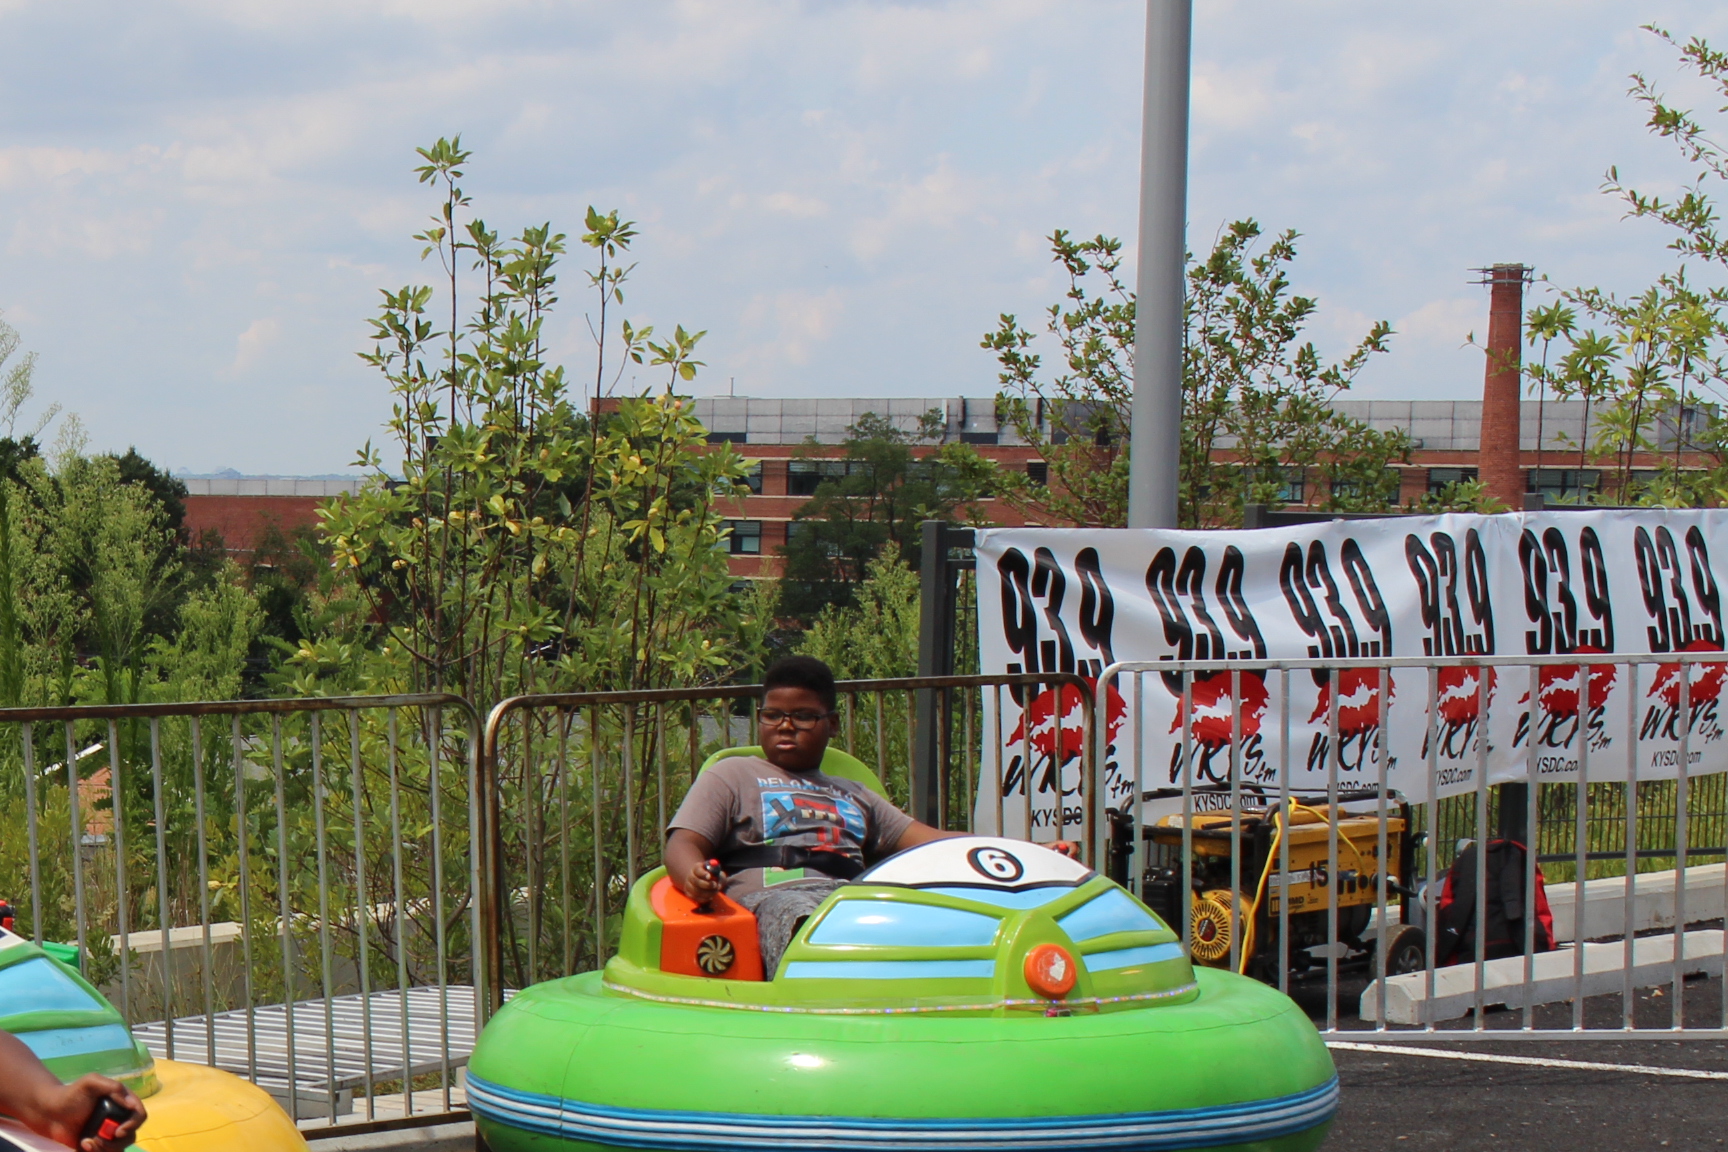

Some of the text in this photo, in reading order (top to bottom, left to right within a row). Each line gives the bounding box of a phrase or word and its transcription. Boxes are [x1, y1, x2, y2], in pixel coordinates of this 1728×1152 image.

[1405, 528, 1494, 656] 93.9
[1518, 526, 1614, 655] 93.9
[1634, 525, 1725, 653] 93.9
[976, 849, 1017, 879] 6
